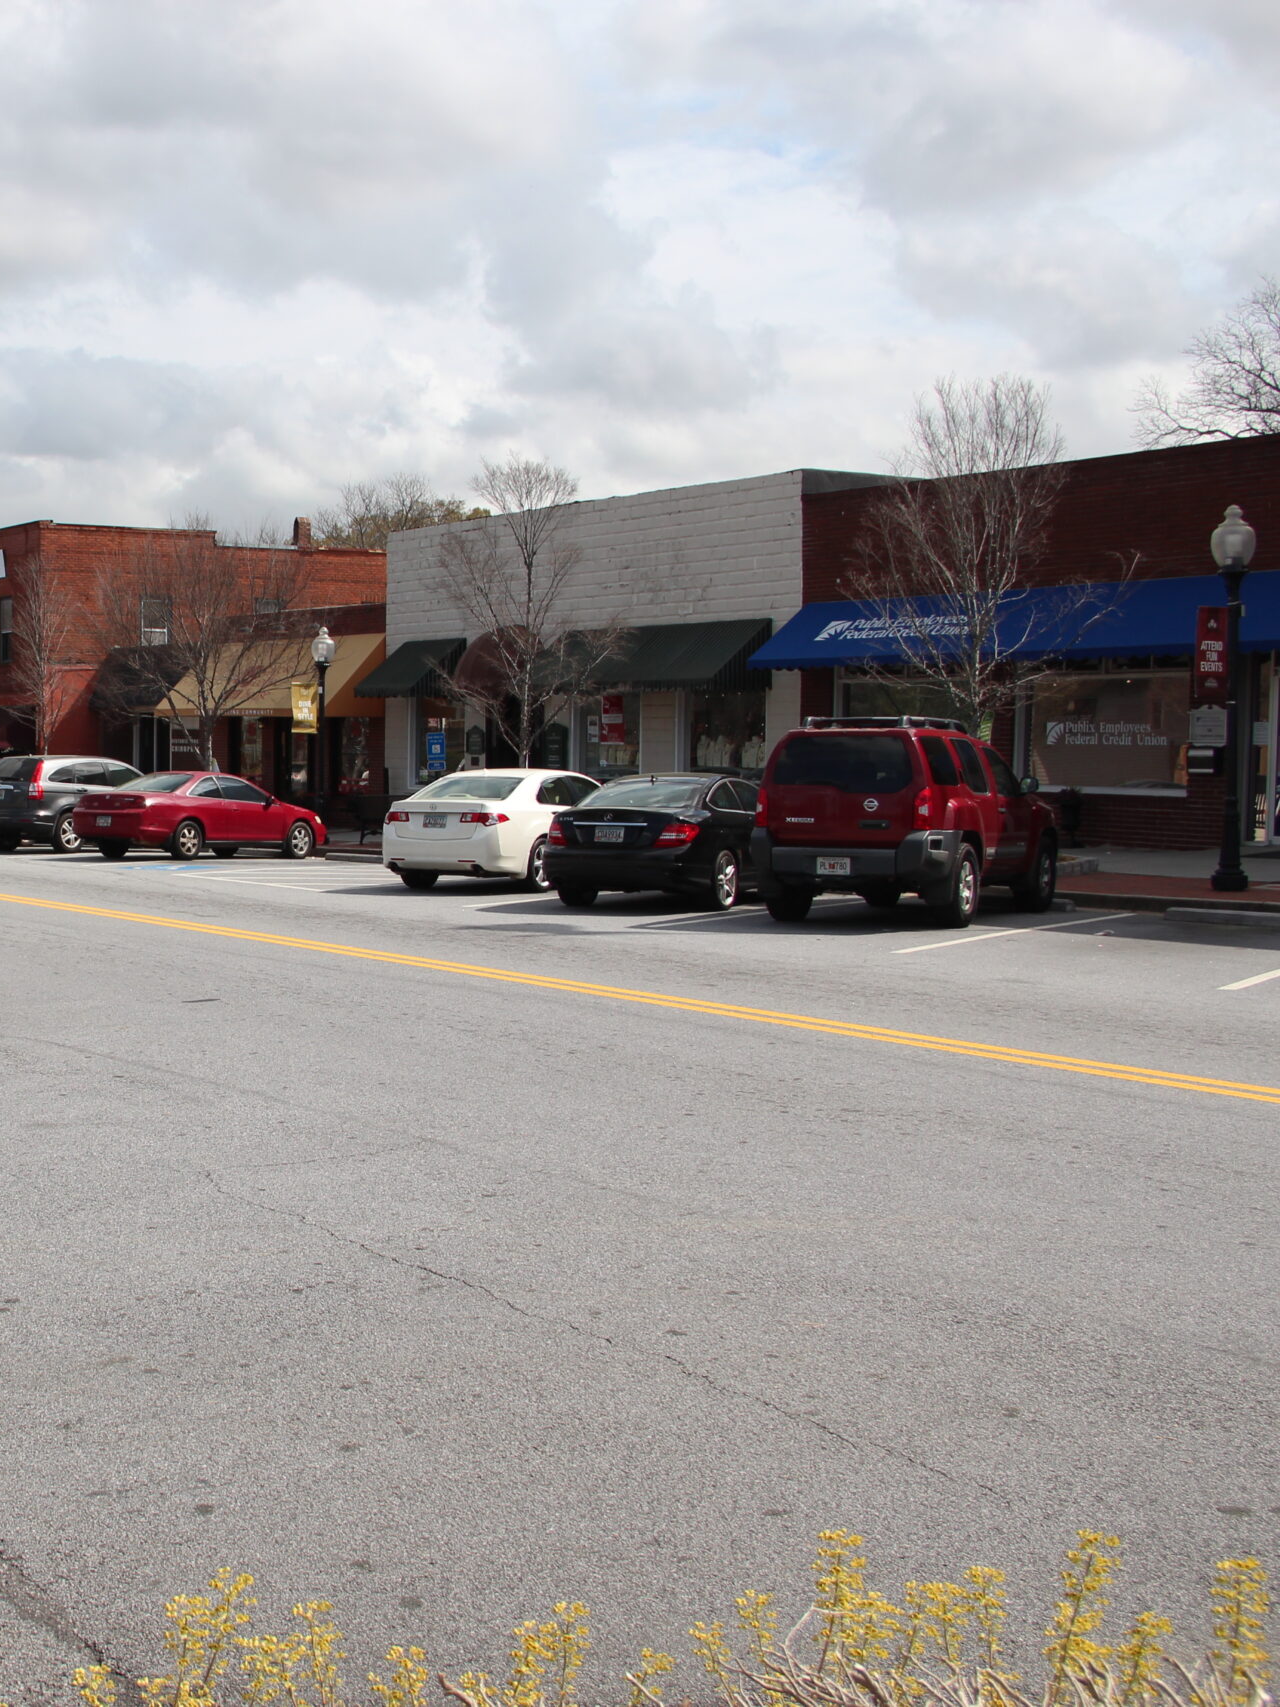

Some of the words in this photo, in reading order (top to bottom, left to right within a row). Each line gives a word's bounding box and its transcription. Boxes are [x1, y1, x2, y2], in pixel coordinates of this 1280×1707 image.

[851, 618, 894, 629] Publix
[838, 629, 890, 640] Federal
[1200, 641, 1223, 651] ATTEND
[1206, 651, 1218, 661] FUN
[1200, 661, 1223, 672] EVENTS
[1065, 720, 1096, 733] Publix
[1100, 721, 1151, 735] Employees
[1065, 733, 1098, 745] Federal
[1102, 733, 1132, 746] Credit
[1137, 733, 1168, 746] Union
